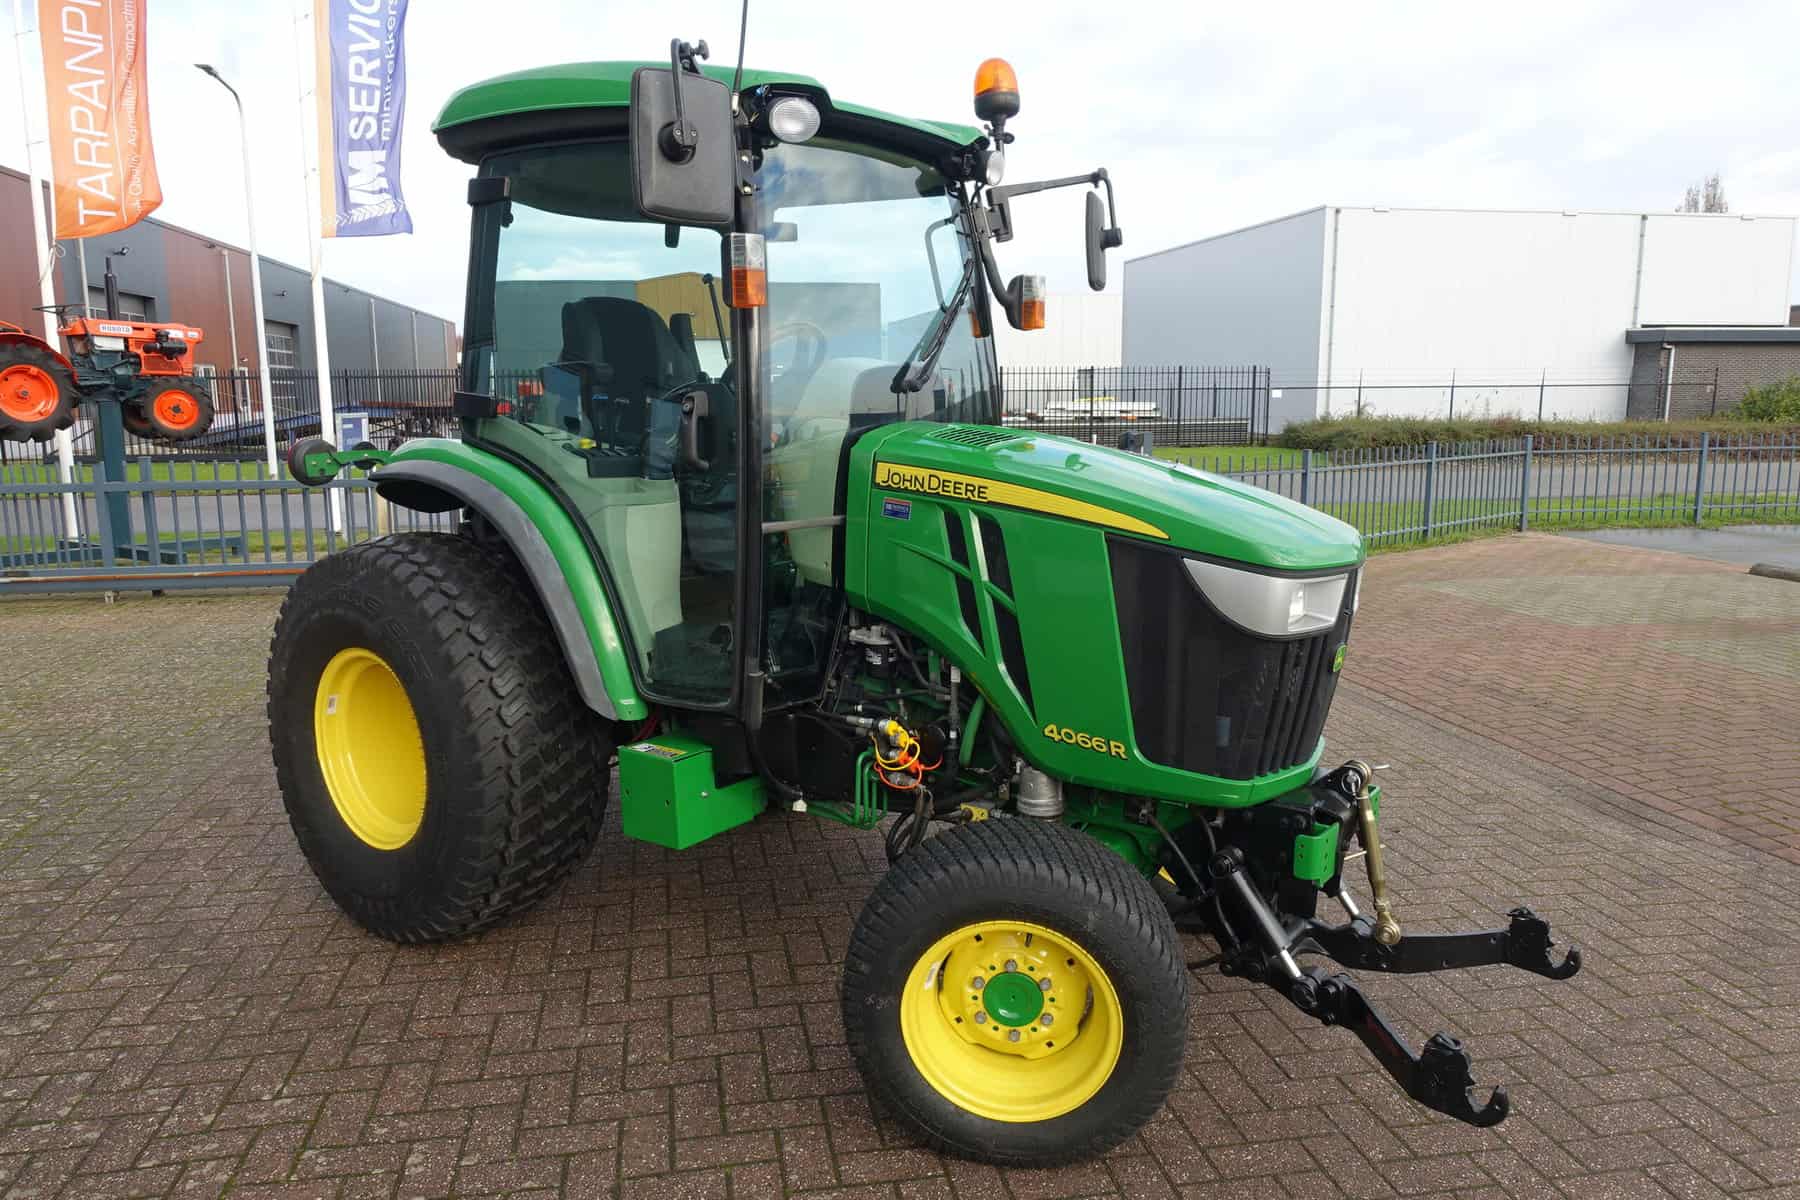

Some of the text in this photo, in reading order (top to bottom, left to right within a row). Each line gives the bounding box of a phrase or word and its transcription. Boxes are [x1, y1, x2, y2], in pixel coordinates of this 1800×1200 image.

[61, 0, 117, 225] TARPANP
[881, 467, 989, 500] JOHN DEERE
[1043, 723, 1129, 760] 4066R
